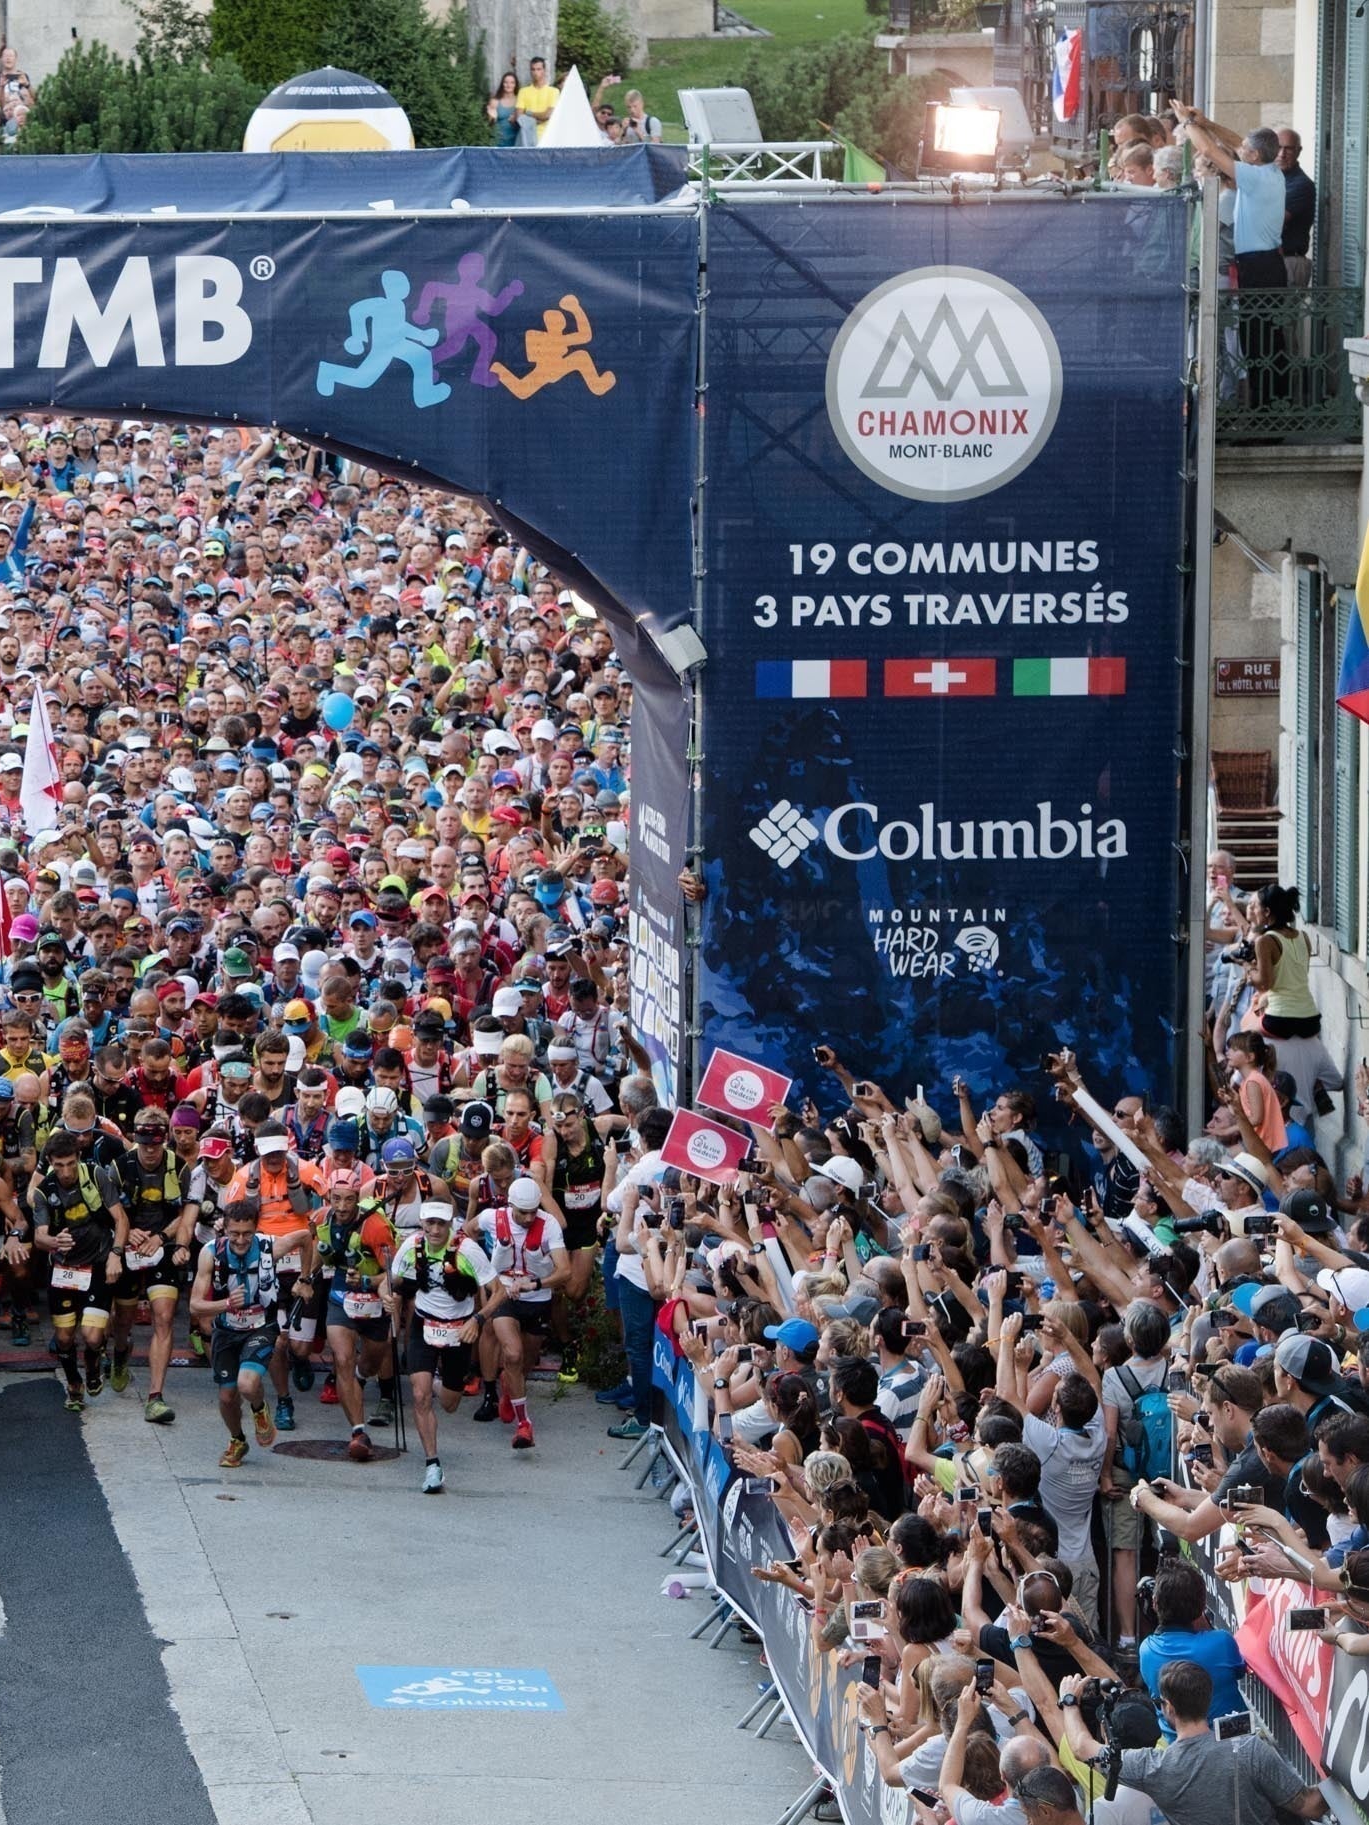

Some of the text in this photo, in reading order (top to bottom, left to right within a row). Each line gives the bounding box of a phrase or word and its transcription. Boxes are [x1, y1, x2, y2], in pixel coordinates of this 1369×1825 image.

[857, 408, 1029, 437] CHAMONIX
[888, 443, 993, 459] MONT-BLANC
[789, 540, 1100, 575] 19 COMMUNES
[753, 582, 1131, 629] 3 PAYS TRAVERSÉS
[1243, 663, 1272, 676] RUE
[823, 801, 1129, 862] Columbia
[869, 908, 1006, 923] MOUNTAIN
[874, 926, 939, 954] HARD
[889, 951, 956, 978] WEAR
[574, 1193, 585, 1201] 20
[62, 1270, 74, 1280] 28
[353, 1302, 365, 1310] 97
[431, 1328, 448, 1337] 102
[450, 1670, 503, 1678] GO!
[496, 1685, 549, 1693] GO!
[415, 1697, 548, 1708] Columbia
